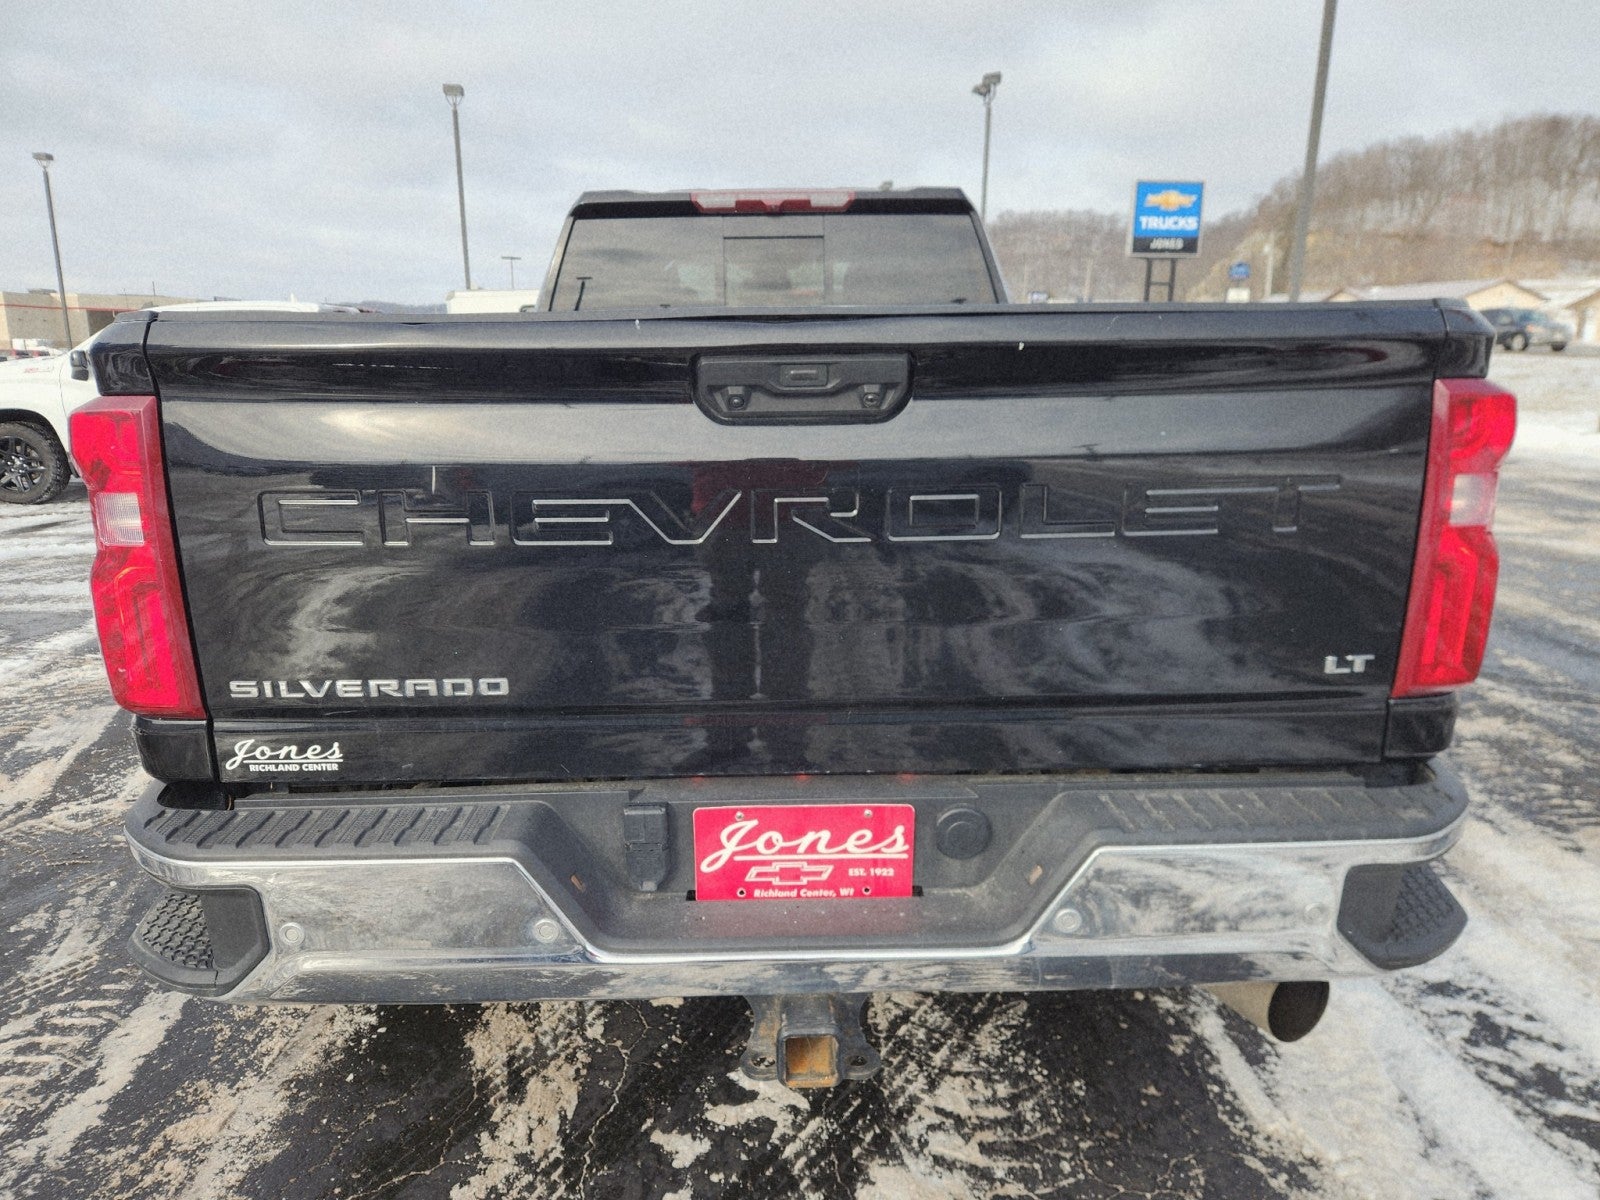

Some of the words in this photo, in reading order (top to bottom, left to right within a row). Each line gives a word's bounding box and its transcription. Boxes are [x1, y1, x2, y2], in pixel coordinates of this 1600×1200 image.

[1139, 215, 1199, 231] TRUCKS
[1149, 237, 1184, 250] JONES
[257, 474, 1341, 546] CHEVROLET
[1324, 654, 1376, 674] LT
[229, 677, 510, 699] SILVERADO
[225, 739, 343, 770] Jones
[249, 763, 300, 772] RICHLAND
[301, 763, 339, 772] CENTER
[700, 818, 910, 874] Jones
[848, 867, 867, 877] EST.
[869, 867, 895, 877] 1922
[753, 888, 798, 898] Richland
[799, 888, 837, 898] Center,
[839, 887, 855, 897] WI
